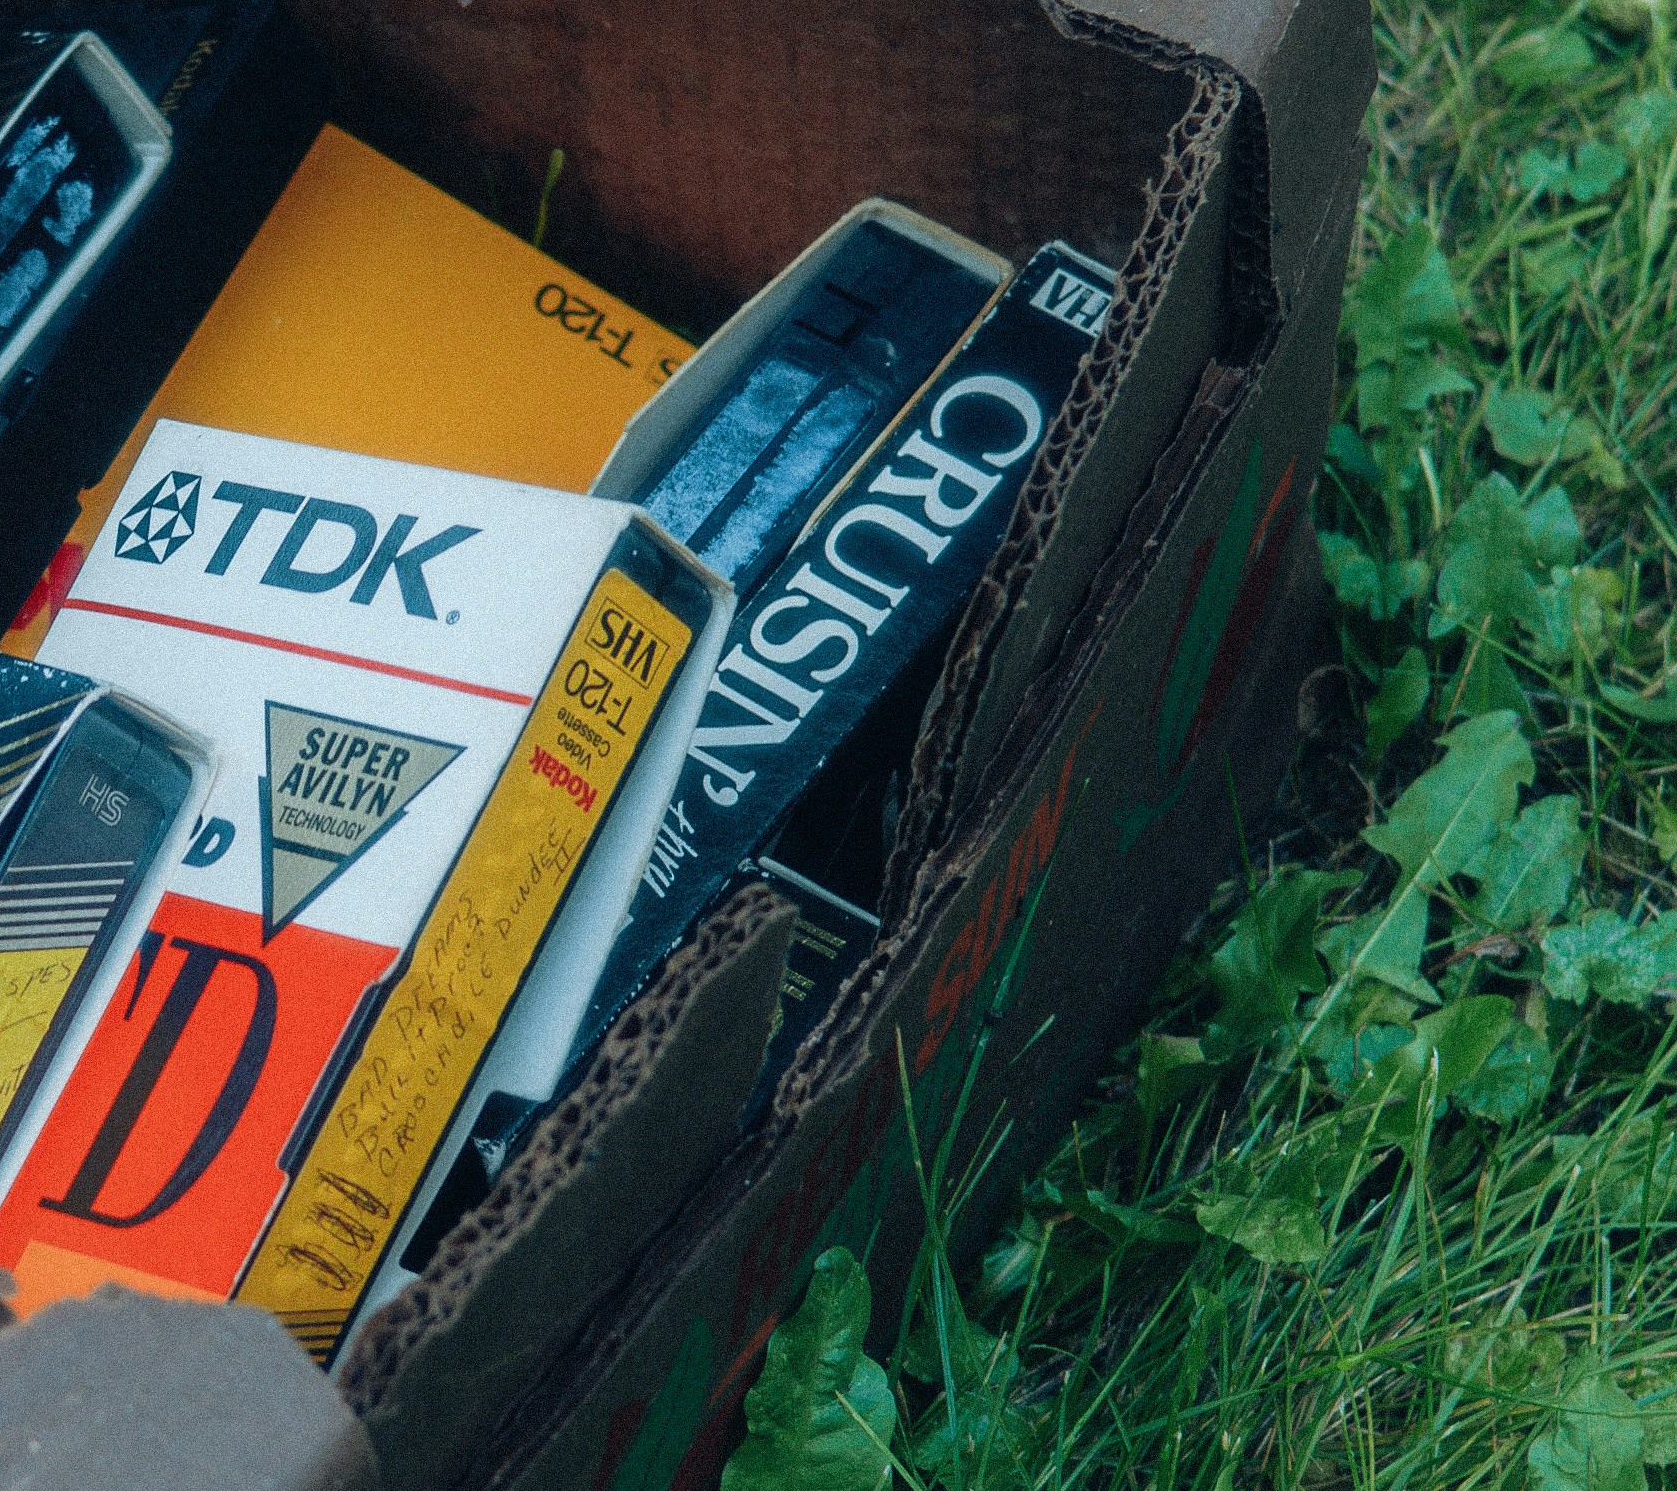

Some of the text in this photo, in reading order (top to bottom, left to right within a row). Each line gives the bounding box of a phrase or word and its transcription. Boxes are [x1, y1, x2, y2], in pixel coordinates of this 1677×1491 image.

[534, 283, 635, 369] T-120
[1045, 273, 1113, 335] VH
[203, 480, 483, 621] TDK
[590, 607, 660, 683] VHS
[564, 659, 633, 737] T-120
[298, 726, 411, 782] SUPER
[556, 706, 612, 771] Video Cassette
[78, 773, 130, 827] HS
[277, 762, 398, 819] AVILYN
[528, 743, 598, 814] Kodak
[278, 804, 366, 841] TECHNOLOGY
[642, 799, 698, 899] thru
